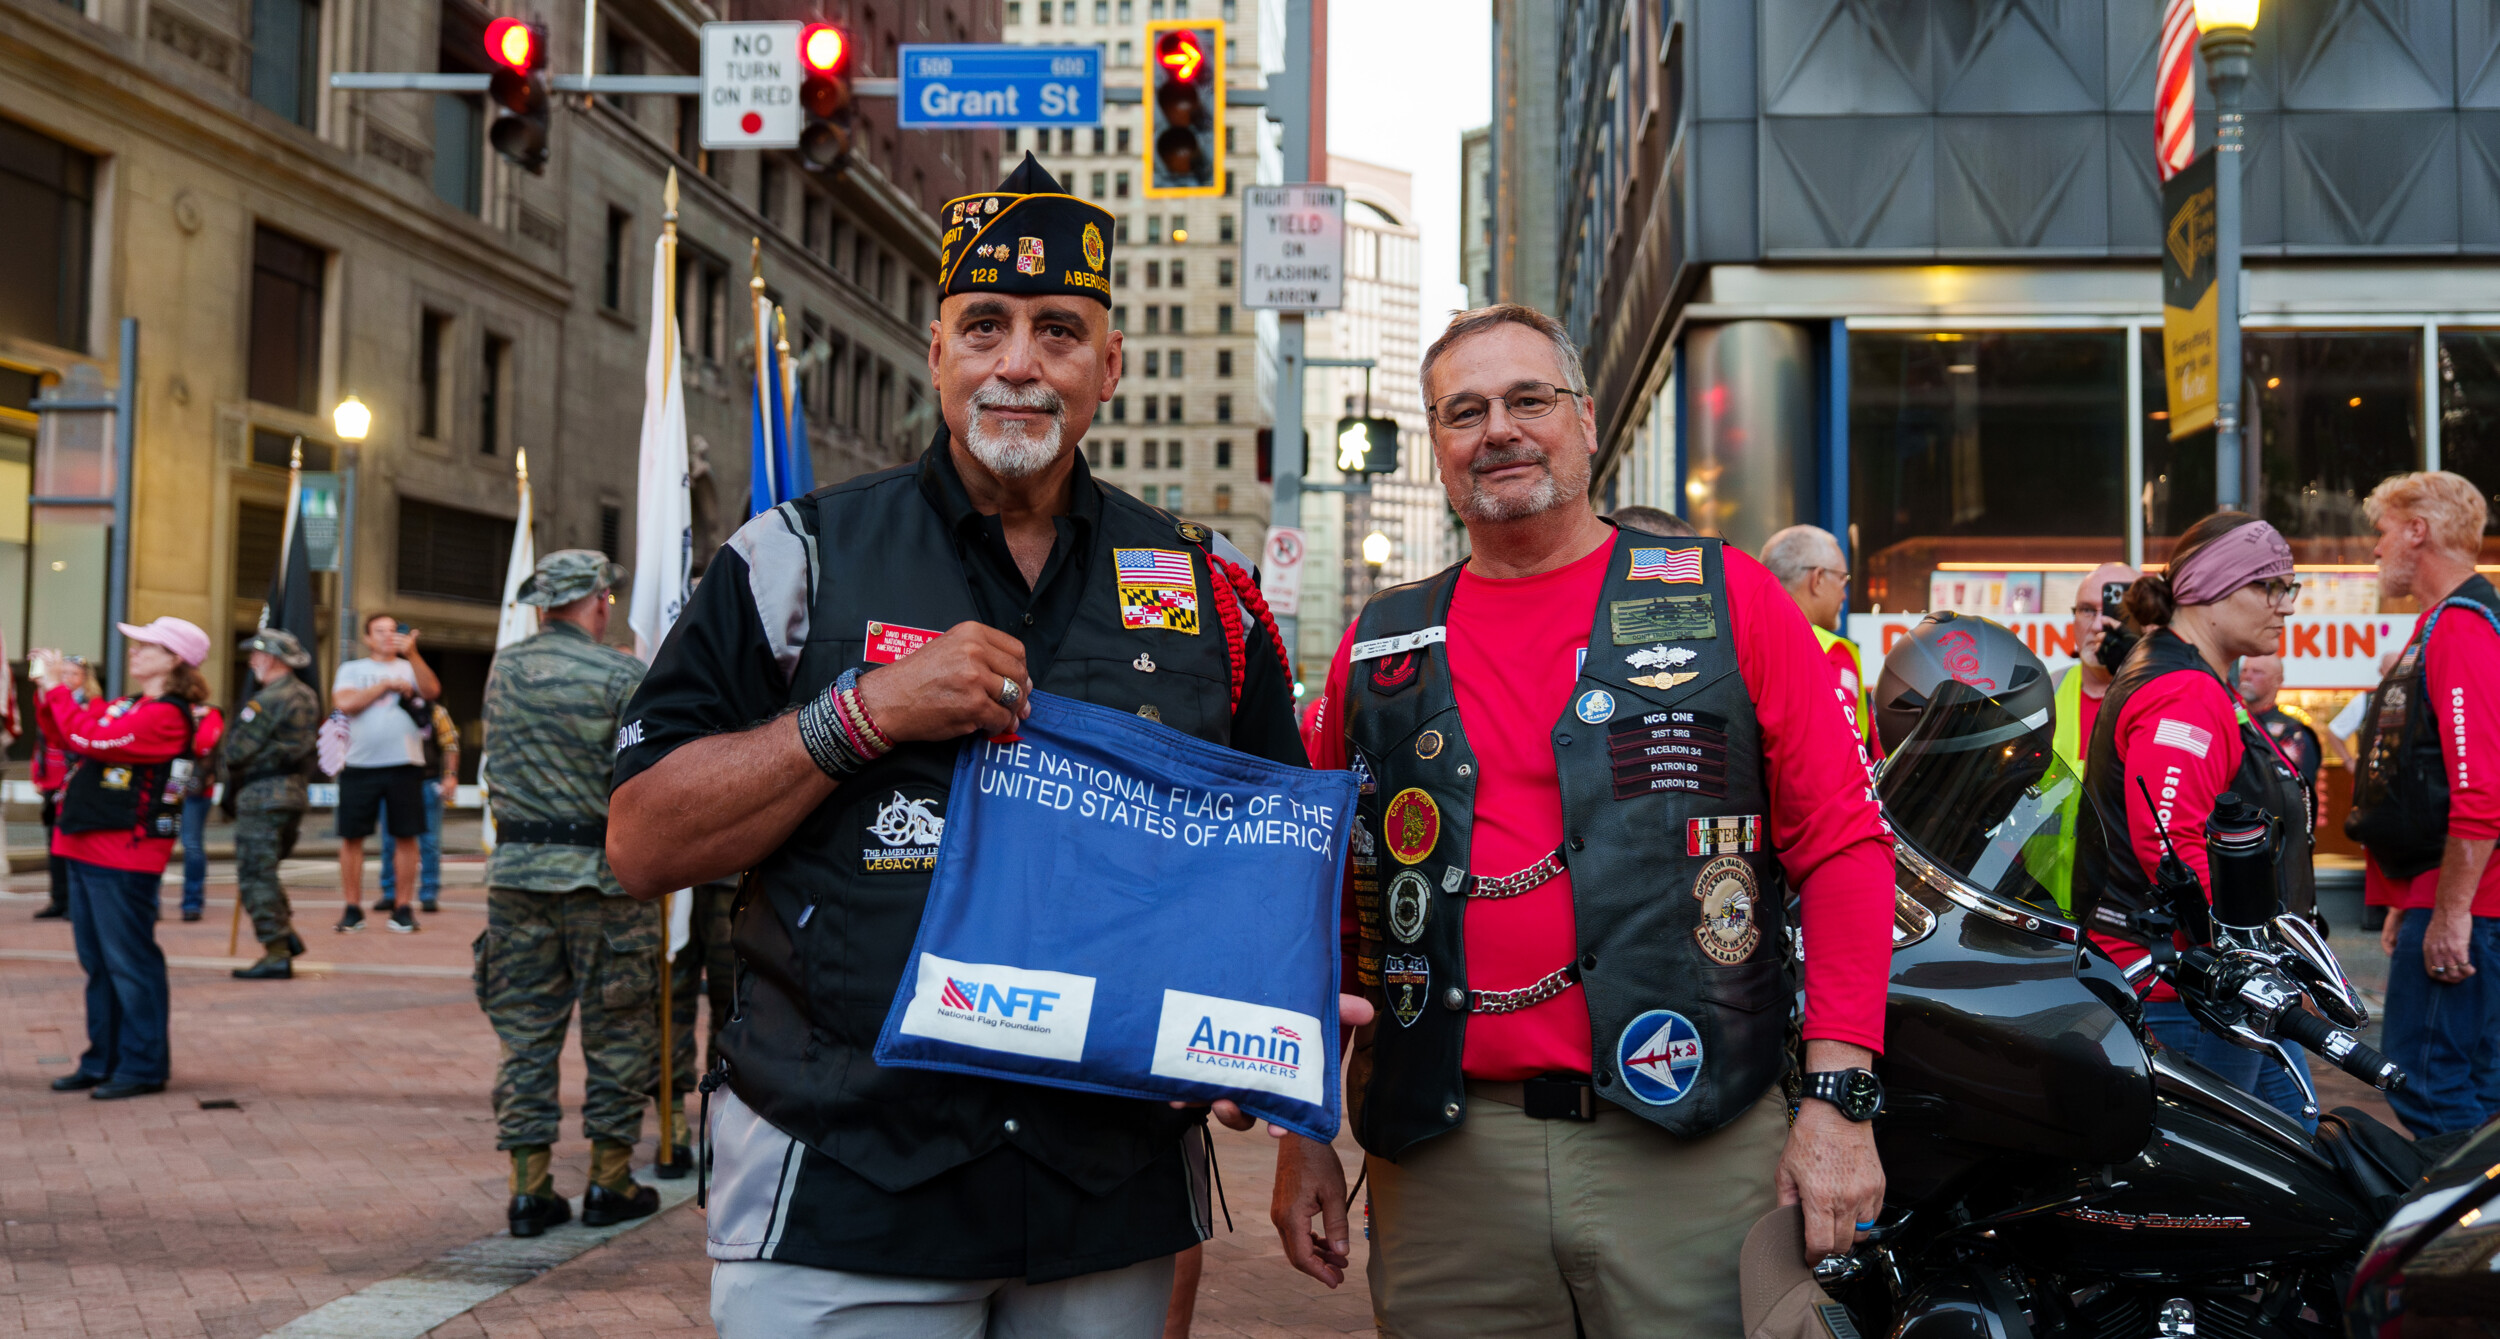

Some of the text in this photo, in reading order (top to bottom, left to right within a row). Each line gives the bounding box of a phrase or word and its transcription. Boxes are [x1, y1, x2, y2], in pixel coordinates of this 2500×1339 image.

[733, 33, 772, 56] NO
[727, 60, 781, 81] TURN
[918, 57, 1086, 76] 500 600
[712, 85, 793, 106] ON RED
[921, 82, 1080, 117] Grant St
[1252, 190, 1336, 207] RIGHT TURN
[1266, 213, 1323, 235] YIELD
[1281, 240, 1306, 258] ON
[971, 268, 998, 283] 128
[1254, 263, 1331, 282] FLASHING
[1265, 287, 1319, 303] ARROW
[884, 638, 907, 647] NATIONAL
[885, 630, 899, 639] DAVID
[876, 644, 902, 653] AMERICAN
[1643, 712, 1694, 724] NCG ONE
[2451, 686, 2467, 757] SOJOURN
[1651, 729, 1690, 738] 31ST SRG
[1644, 745, 1702, 756] TACELRON 34
[1651, 762, 1698, 772] PATRON 90
[985, 740, 1333, 830] THE NATIONAL FLAG OF THE
[1651, 779, 1699, 789] ATKRON 122
[980, 765, 1332, 861] UNITED STATES OF AMERICA
[1390, 794, 1409, 817] CHINA
[1414, 792, 1431, 808] POST
[1692, 826, 1758, 845] VETERAN
[864, 847, 938, 857] THE AMERICAN LE
[866, 857, 920, 870] LEGACY
[1697, 858, 1725, 895] OPERATION
[1725, 857, 1741, 869] IRAQI
[1729, 939, 1740, 949] WE
[1390, 960, 1424, 970] US 421
[977, 983, 1061, 1022] NFF
[937, 1008, 1051, 1034] National Flag Foundation
[1188, 1016, 1300, 1066] Annin
[1186, 1052, 1297, 1079] FLAGMAKERS
